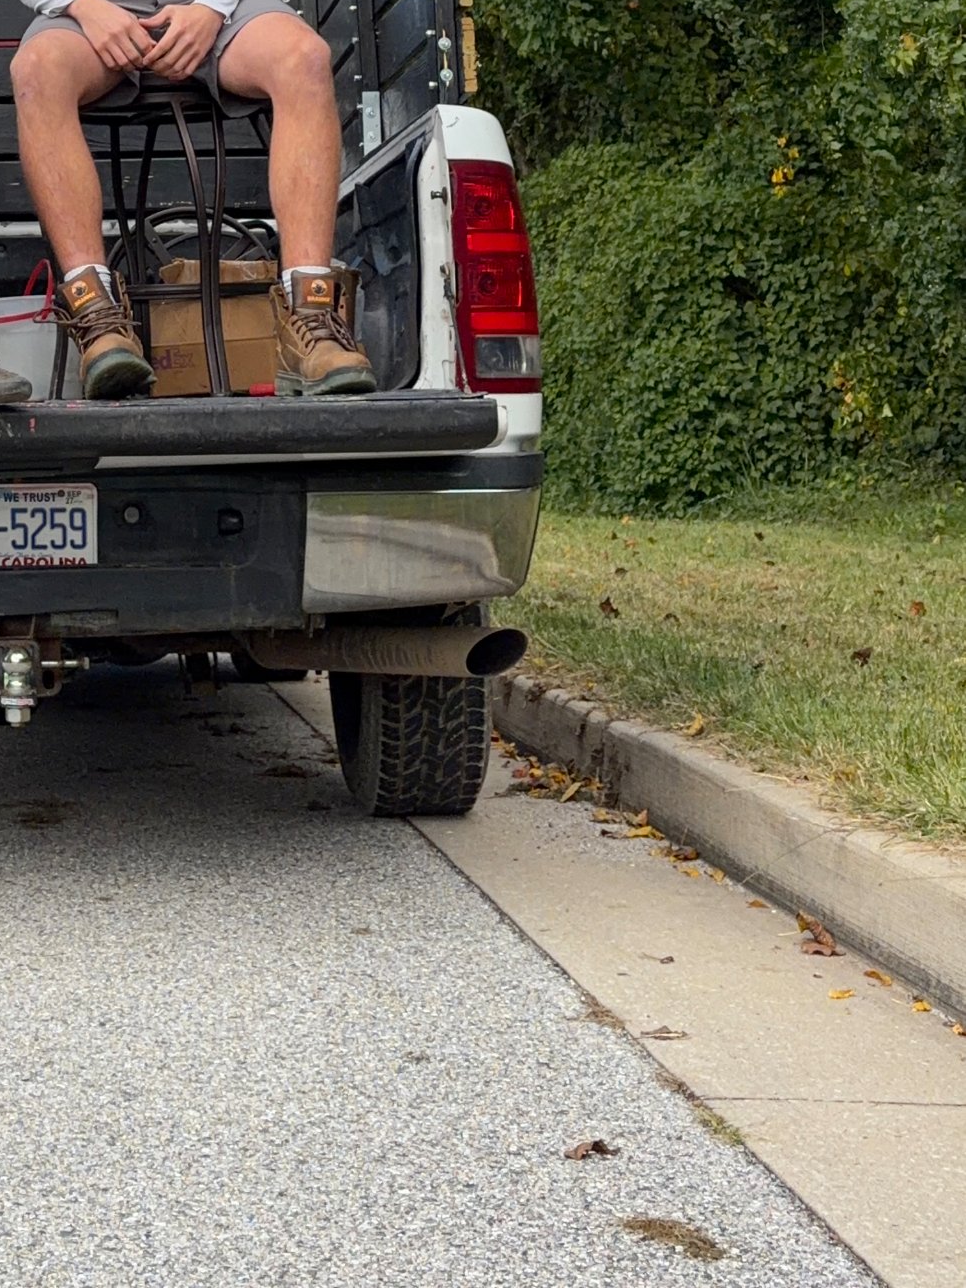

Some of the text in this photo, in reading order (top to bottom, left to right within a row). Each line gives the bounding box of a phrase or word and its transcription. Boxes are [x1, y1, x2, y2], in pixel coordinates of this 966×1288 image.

[151, 348, 195, 370] edEx
[4, 492, 20, 502] WE
[24, 492, 57, 502] TRUST
[1, 557, 88, 567] CAROLINA
